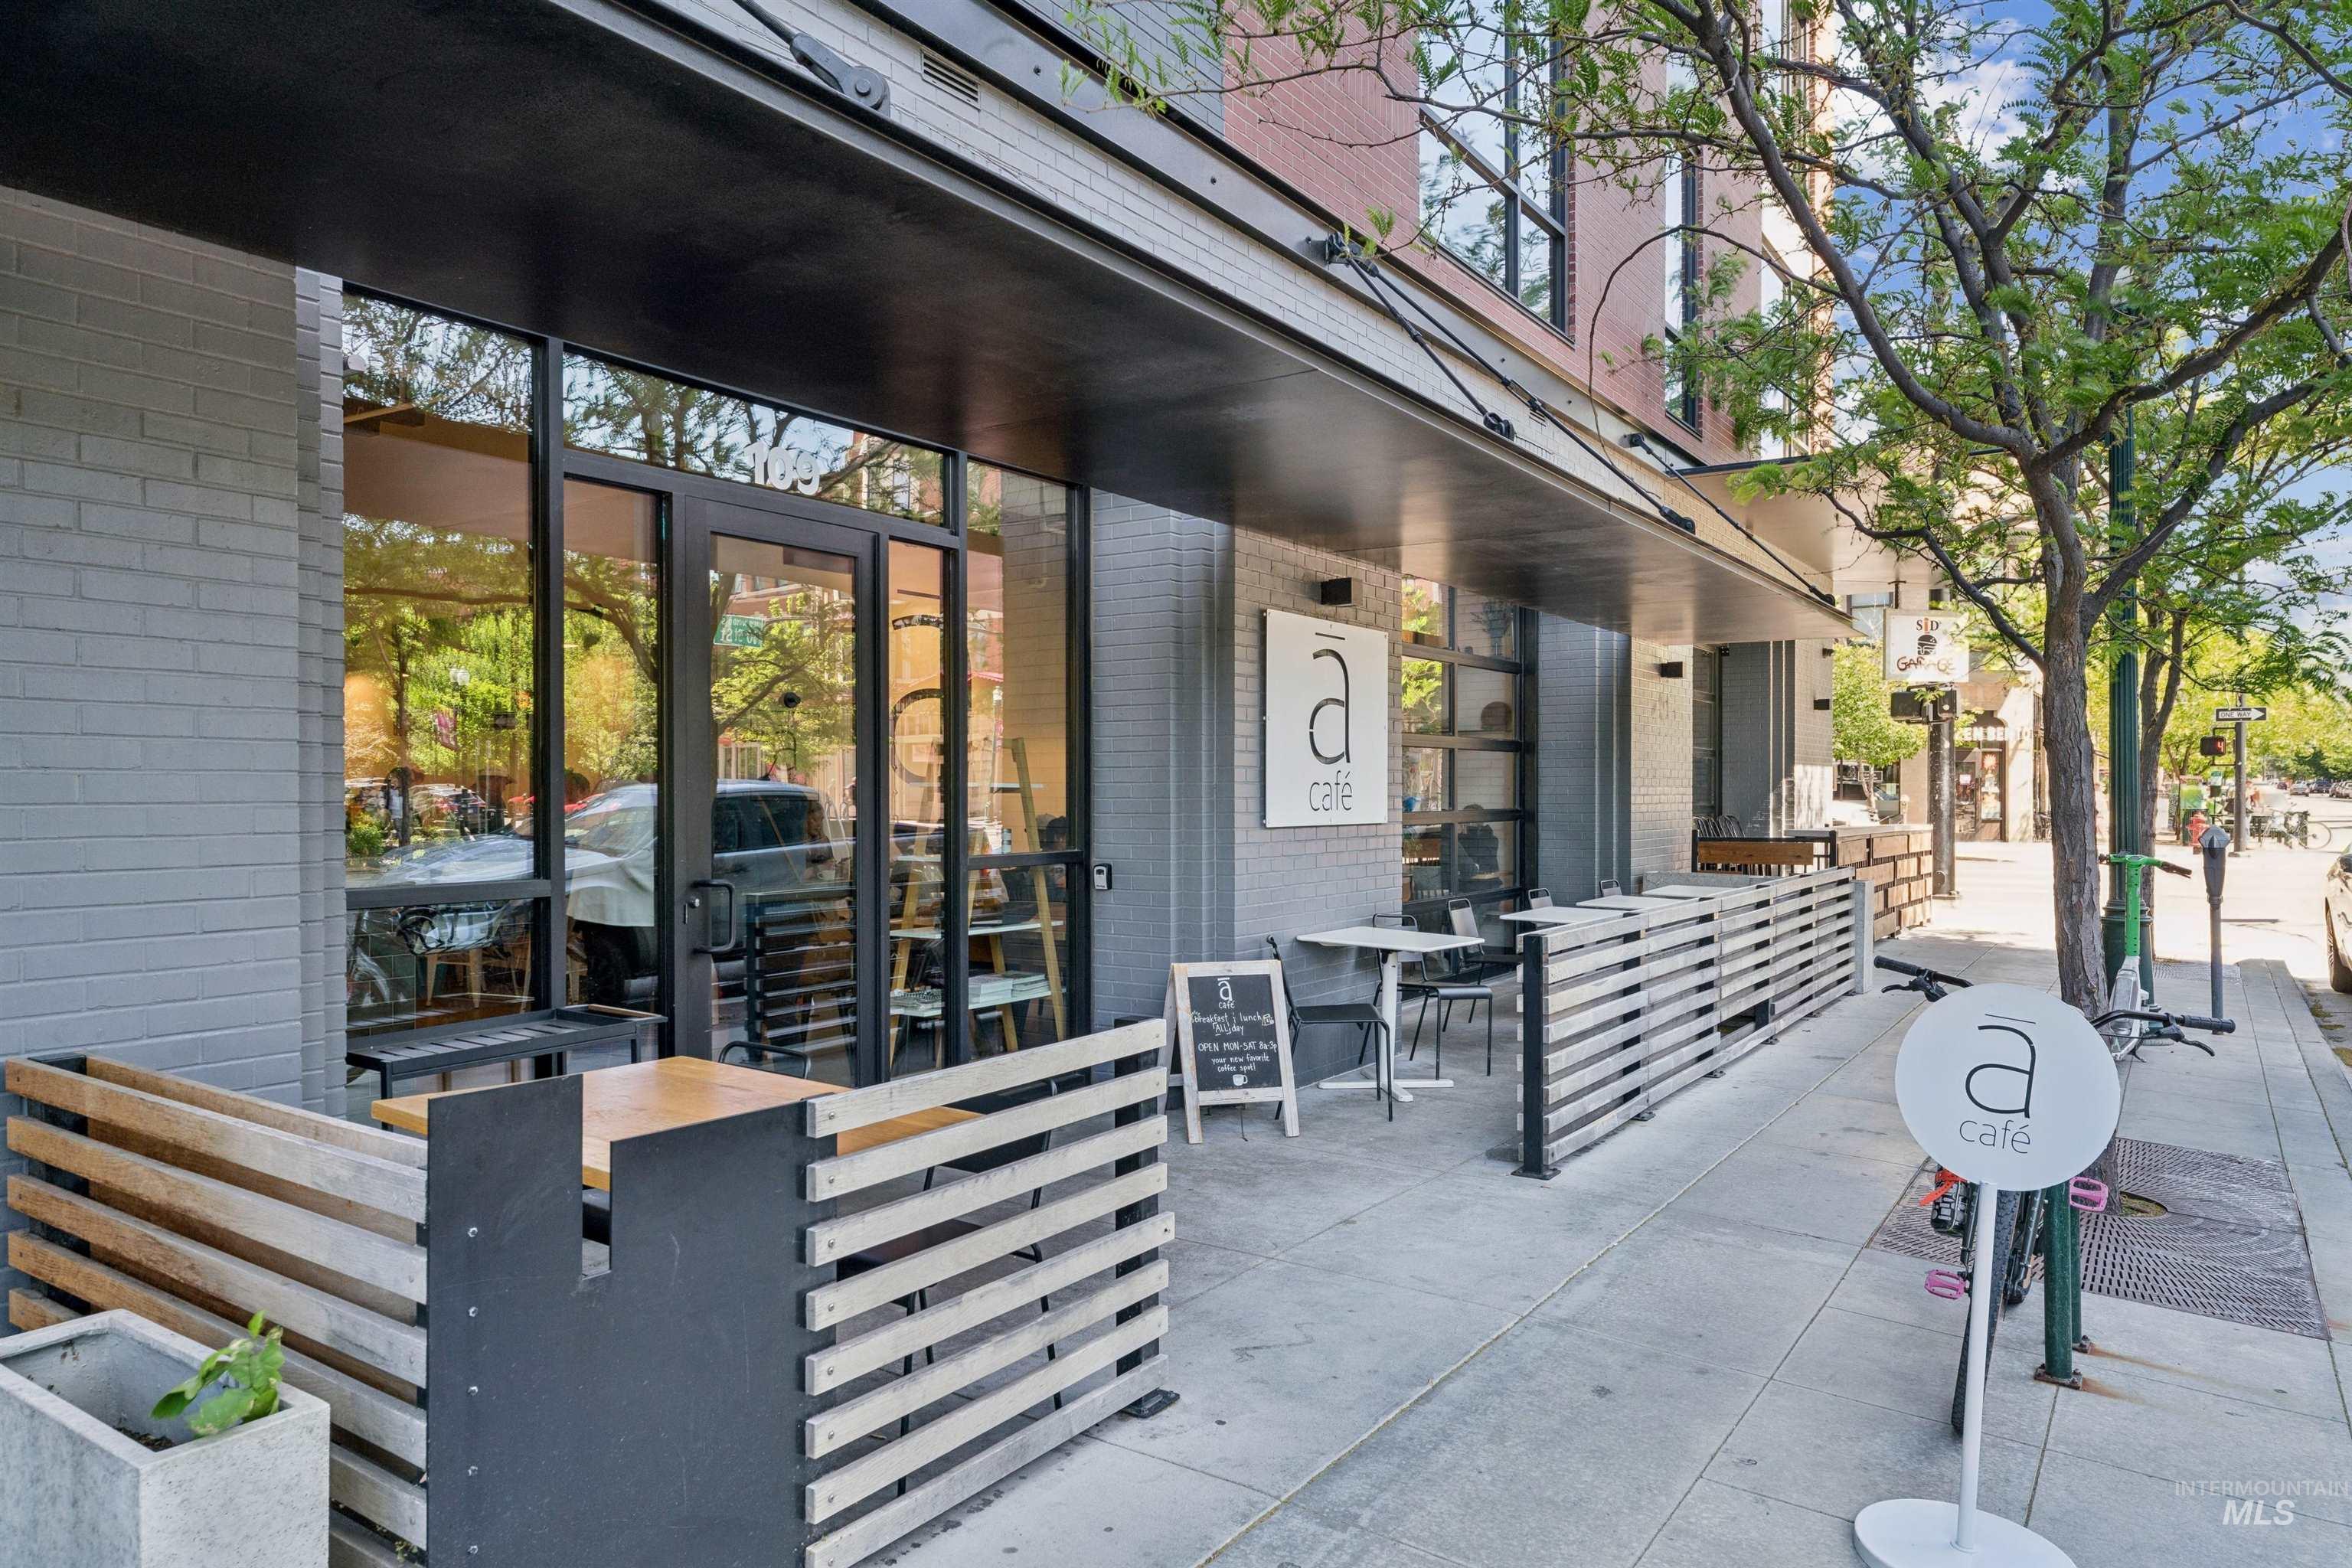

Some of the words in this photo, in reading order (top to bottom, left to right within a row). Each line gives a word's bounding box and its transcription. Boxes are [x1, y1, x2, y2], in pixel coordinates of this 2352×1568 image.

[743, 441, 820, 495] 109
[1955, 727, 1984, 741] EN
[2216, 740, 2224, 753] 4
[1309, 770, 1352, 812] café
[1218, 1000, 1235, 1009] café
[1194, 1012, 1227, 1023] breakfast
[1240, 1011, 1262, 1021] lunch
[1215, 1024, 1229, 1033] ALL
[1231, 1023, 1244, 1036] day
[1197, 1042, 1219, 1052] OPEN
[1223, 1041, 1256, 1051] MON-SAT
[1259, 1040, 1278, 1053] 8a-3p
[1246, 1052, 1270, 1062] favorite
[1217, 1064, 1236, 1073] coffee
[1240, 1063, 1256, 1073] spot!
[1959, 1120, 2030, 1153] café
